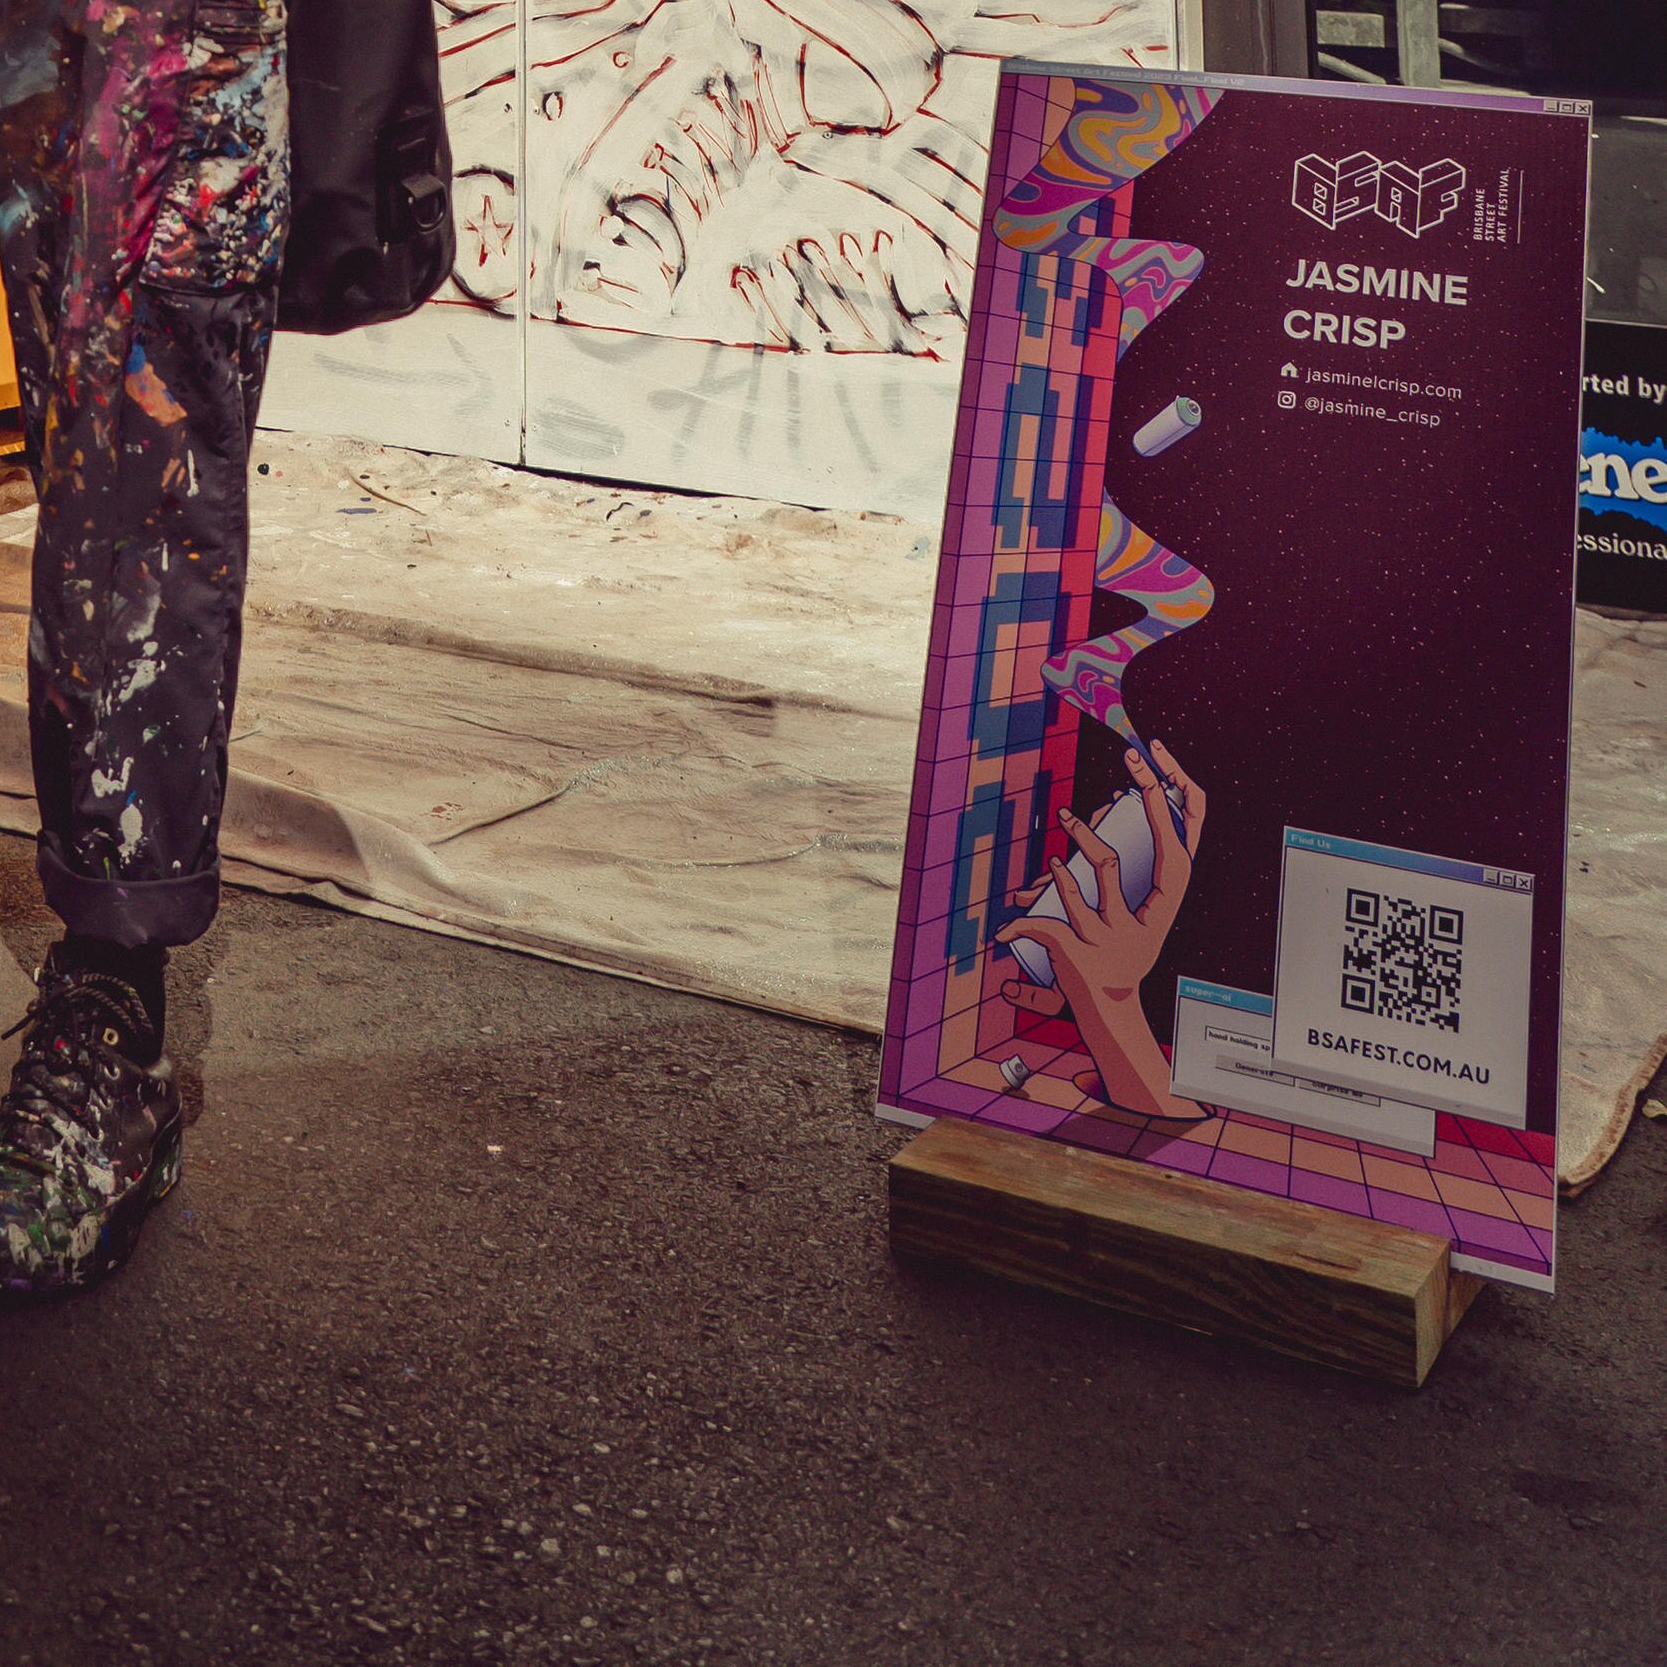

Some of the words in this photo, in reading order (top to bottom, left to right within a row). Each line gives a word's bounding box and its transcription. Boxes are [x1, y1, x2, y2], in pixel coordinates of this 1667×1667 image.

[1473, 187, 1486, 242] BRISBANE
[1498, 168, 1511, 223] FESTIVAL
[1485, 202, 1497, 243] STREET
[1497, 224, 1508, 244] ART
[1285, 258, 1469, 306] JASMINE
[1283, 309, 1407, 350] CRISP
[1638, 376, 1667, 405] by
[1304, 396, 1441, 428] @jasmine_crisp
[1290, 834, 1314, 847] Find
[1317, 838, 1331, 849] Us
[1230, 1036, 1258, 1050] holding
[1307, 1028, 1491, 1085] BSAFEST.COM.AU
